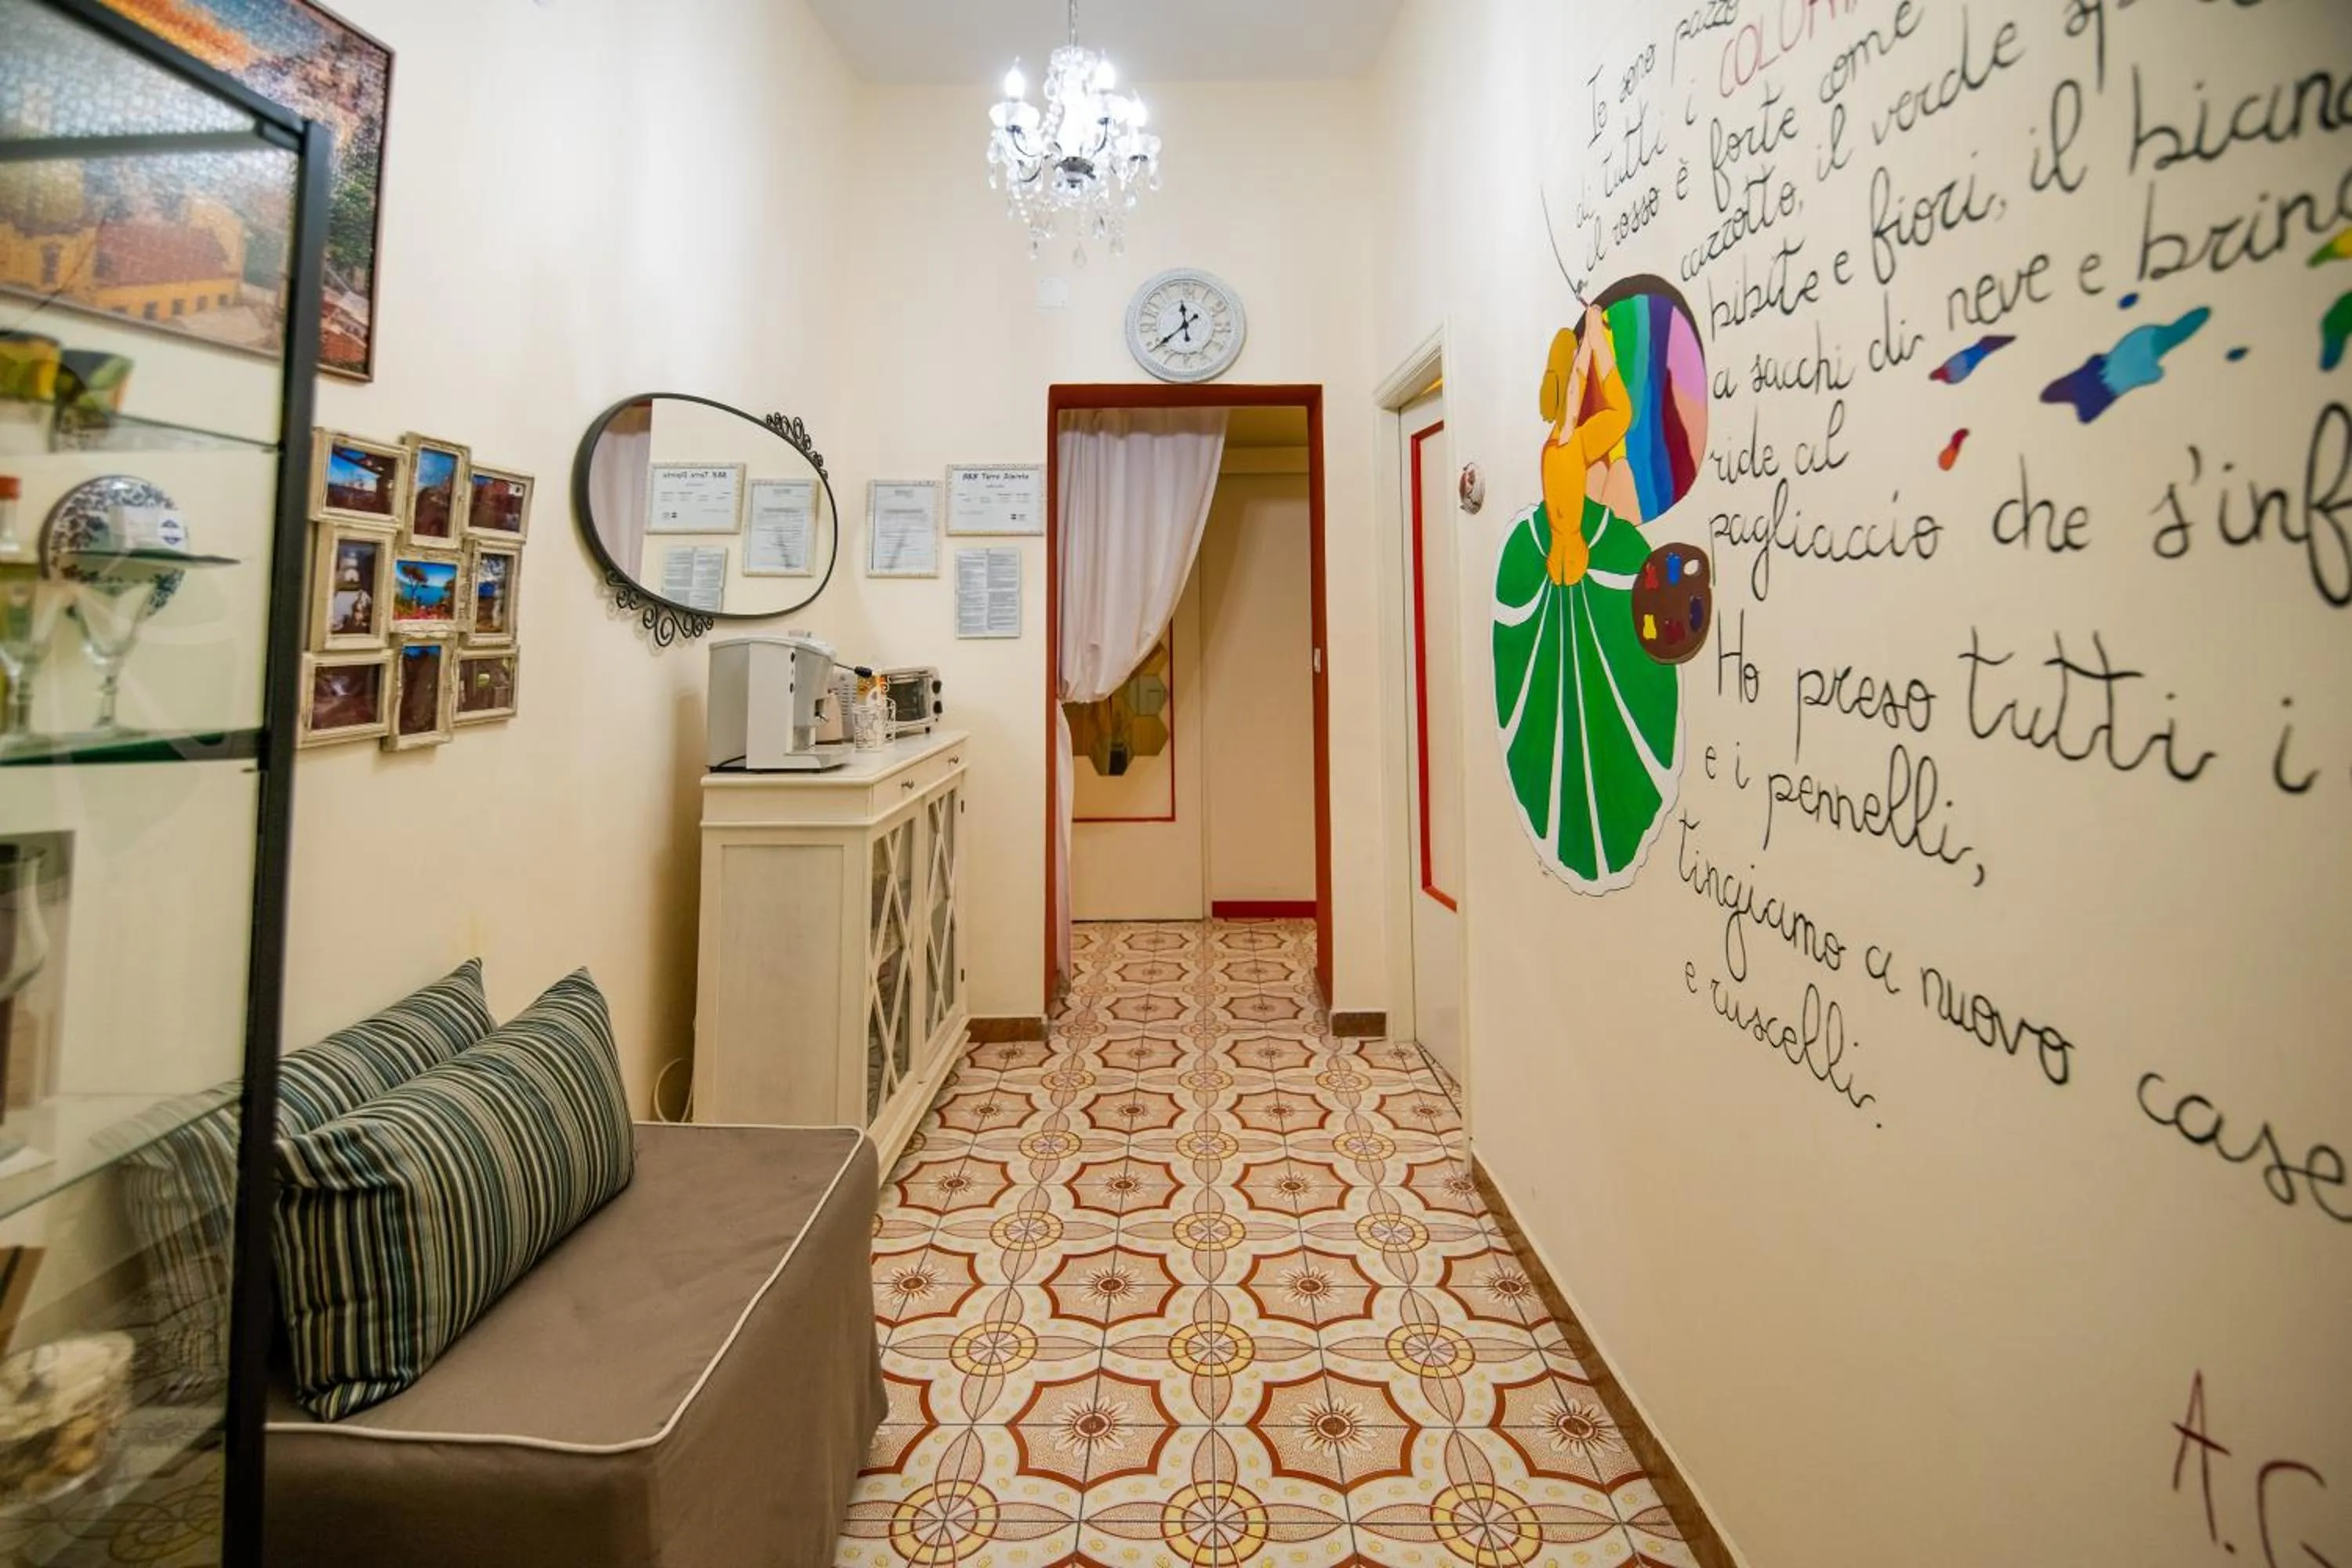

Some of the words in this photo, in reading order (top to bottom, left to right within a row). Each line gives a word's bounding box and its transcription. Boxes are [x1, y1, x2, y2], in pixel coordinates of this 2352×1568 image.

[1612, 186, 1661, 246] rosso
[1676, 158, 1690, 201] è
[1710, 79, 1798, 212] forte
[1819, 0, 1924, 103] come
[1619, 43, 1656, 103] sono
[1670, 0, 1738, 88] pazzo
[1817, 103, 1853, 182] il
[1871, 5, 2027, 147] verde
[1602, 95, 1667, 198] tutti
[1686, 78, 1698, 125] i
[1833, 250, 1855, 285] e
[2029, 78, 2088, 194] il
[1713, 367, 1738, 400] a
[1751, 318, 1857, 395] sacchi
[1869, 289, 1926, 372] di
[1946, 252, 2053, 331] neve
[2078, 252, 2107, 296] e
[1708, 402, 1780, 484] ride
[1794, 398, 1850, 475] al
[1708, 478, 1945, 601] pagliaccio
[1991, 453, 2091, 552] che
[1716, 608, 1760, 704] Ho
[1795, 665, 1936, 765] preso
[1958, 625, 2218, 783] tutti
[2273, 695, 2322, 797] i
[1704, 743, 1717, 780] e
[1734, 742, 1751, 789] i
[1763, 744, 1987, 888] pennelli,
[1679, 808, 1846, 982] tingiamo
[1865, 944, 1900, 995] a
[1921, 966, 2075, 1086] nuovo
[1684, 960, 1698, 995] e
